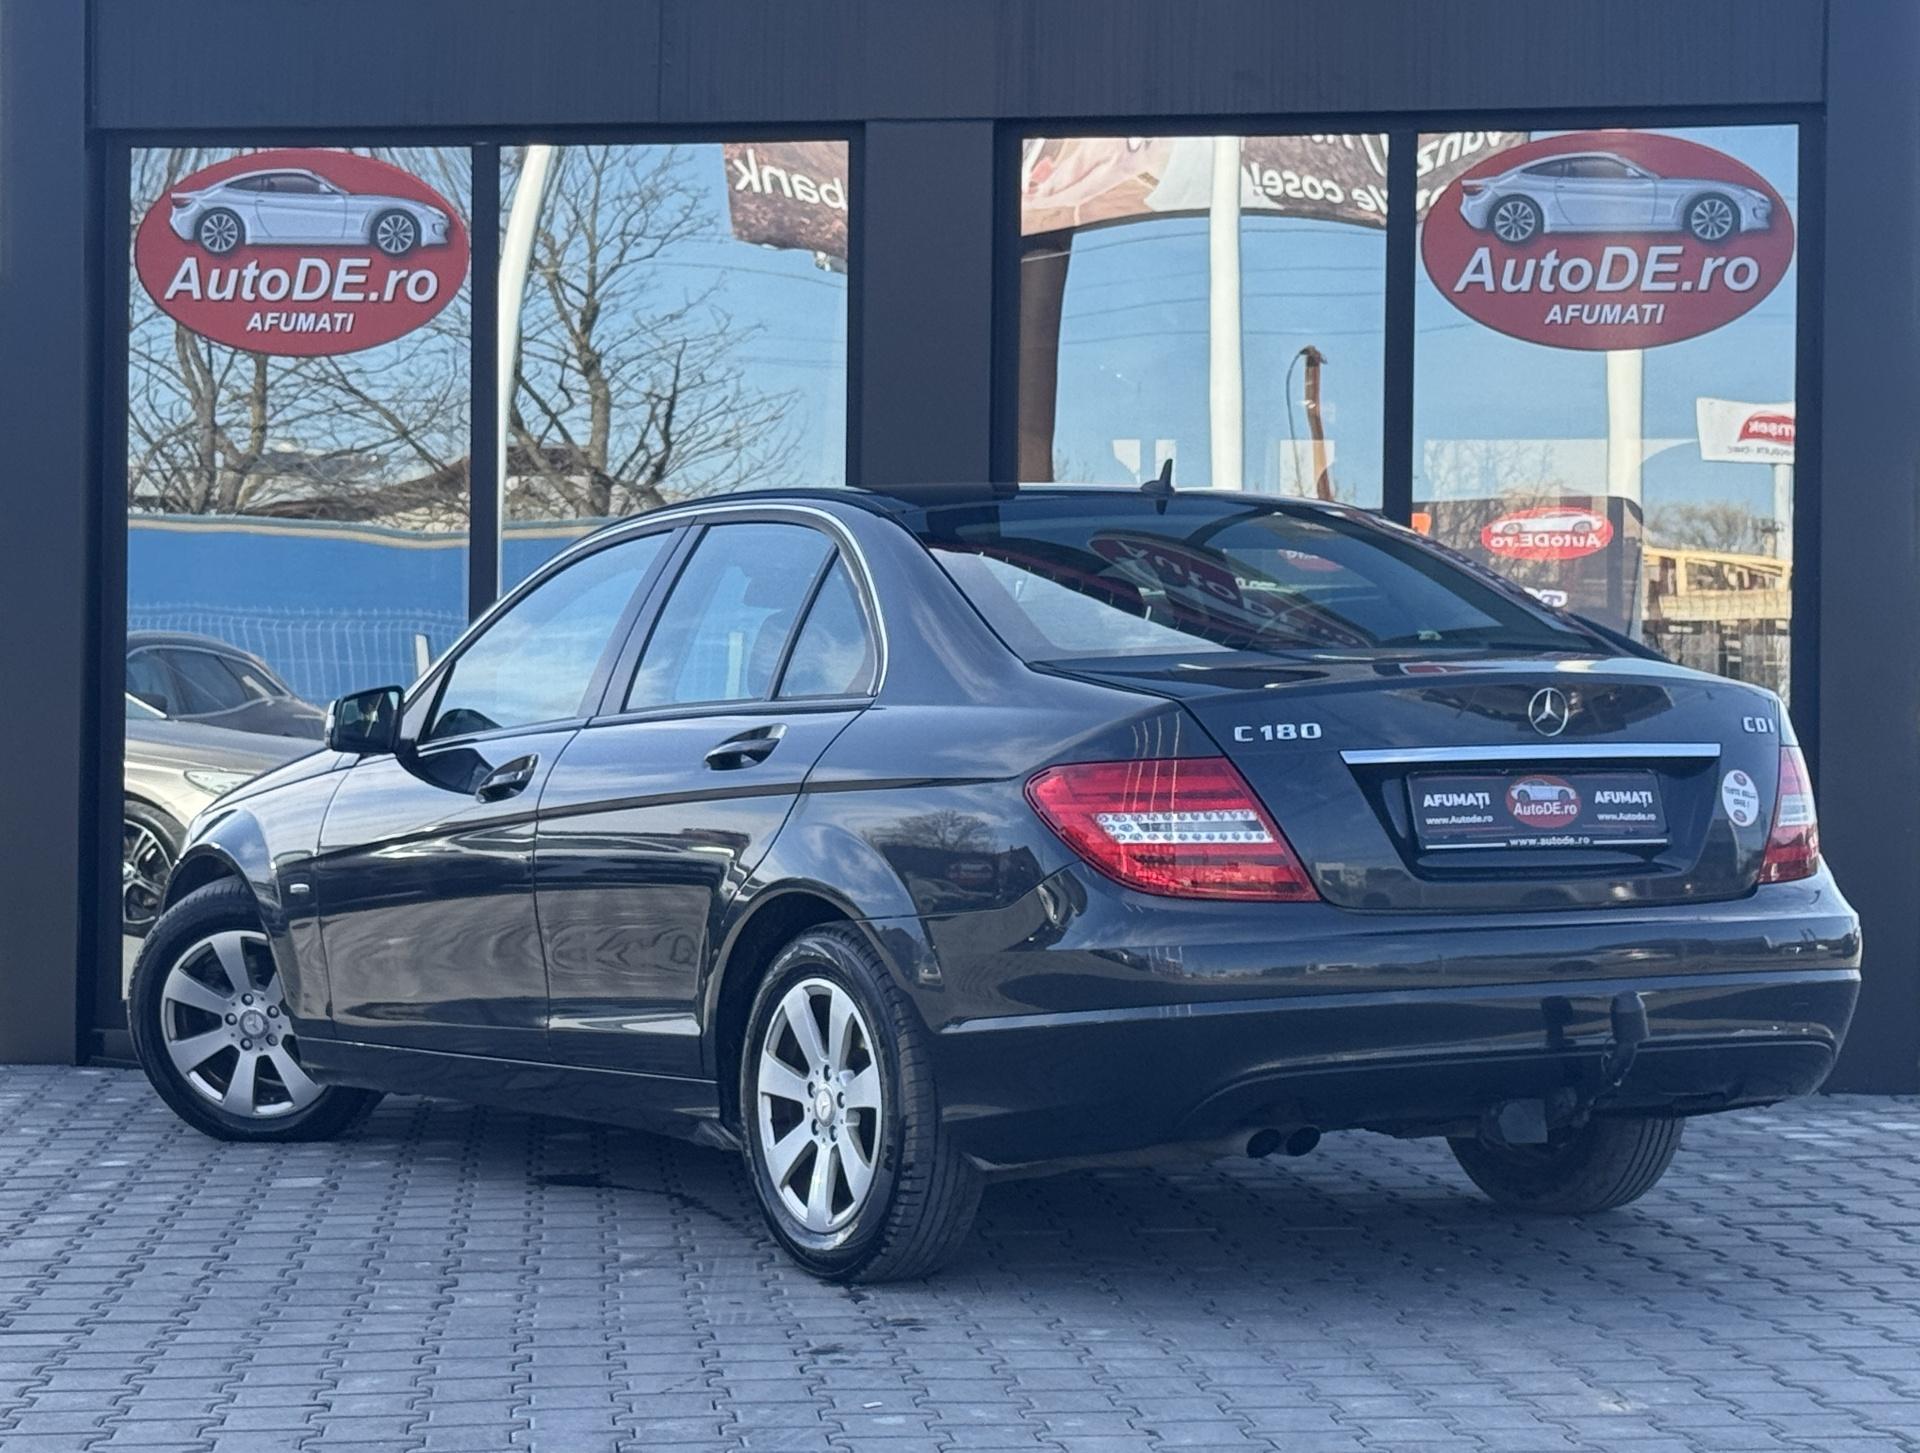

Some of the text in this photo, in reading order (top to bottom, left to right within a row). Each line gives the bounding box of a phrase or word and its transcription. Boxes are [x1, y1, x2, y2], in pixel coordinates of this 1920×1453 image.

[164, 256, 439, 302] AutoDE.ro
[1453, 245, 1760, 293] AutoDE.ro
[246, 311, 355, 334] AFUMATI
[1544, 303, 1666, 326] AFUMATI
[1234, 722, 1322, 742] C 180
[1742, 716, 1776, 734] CDI
[1513, 801, 1578, 816] AutoDE.ro
[1509, 835, 1591, 847] www.autode.ro
